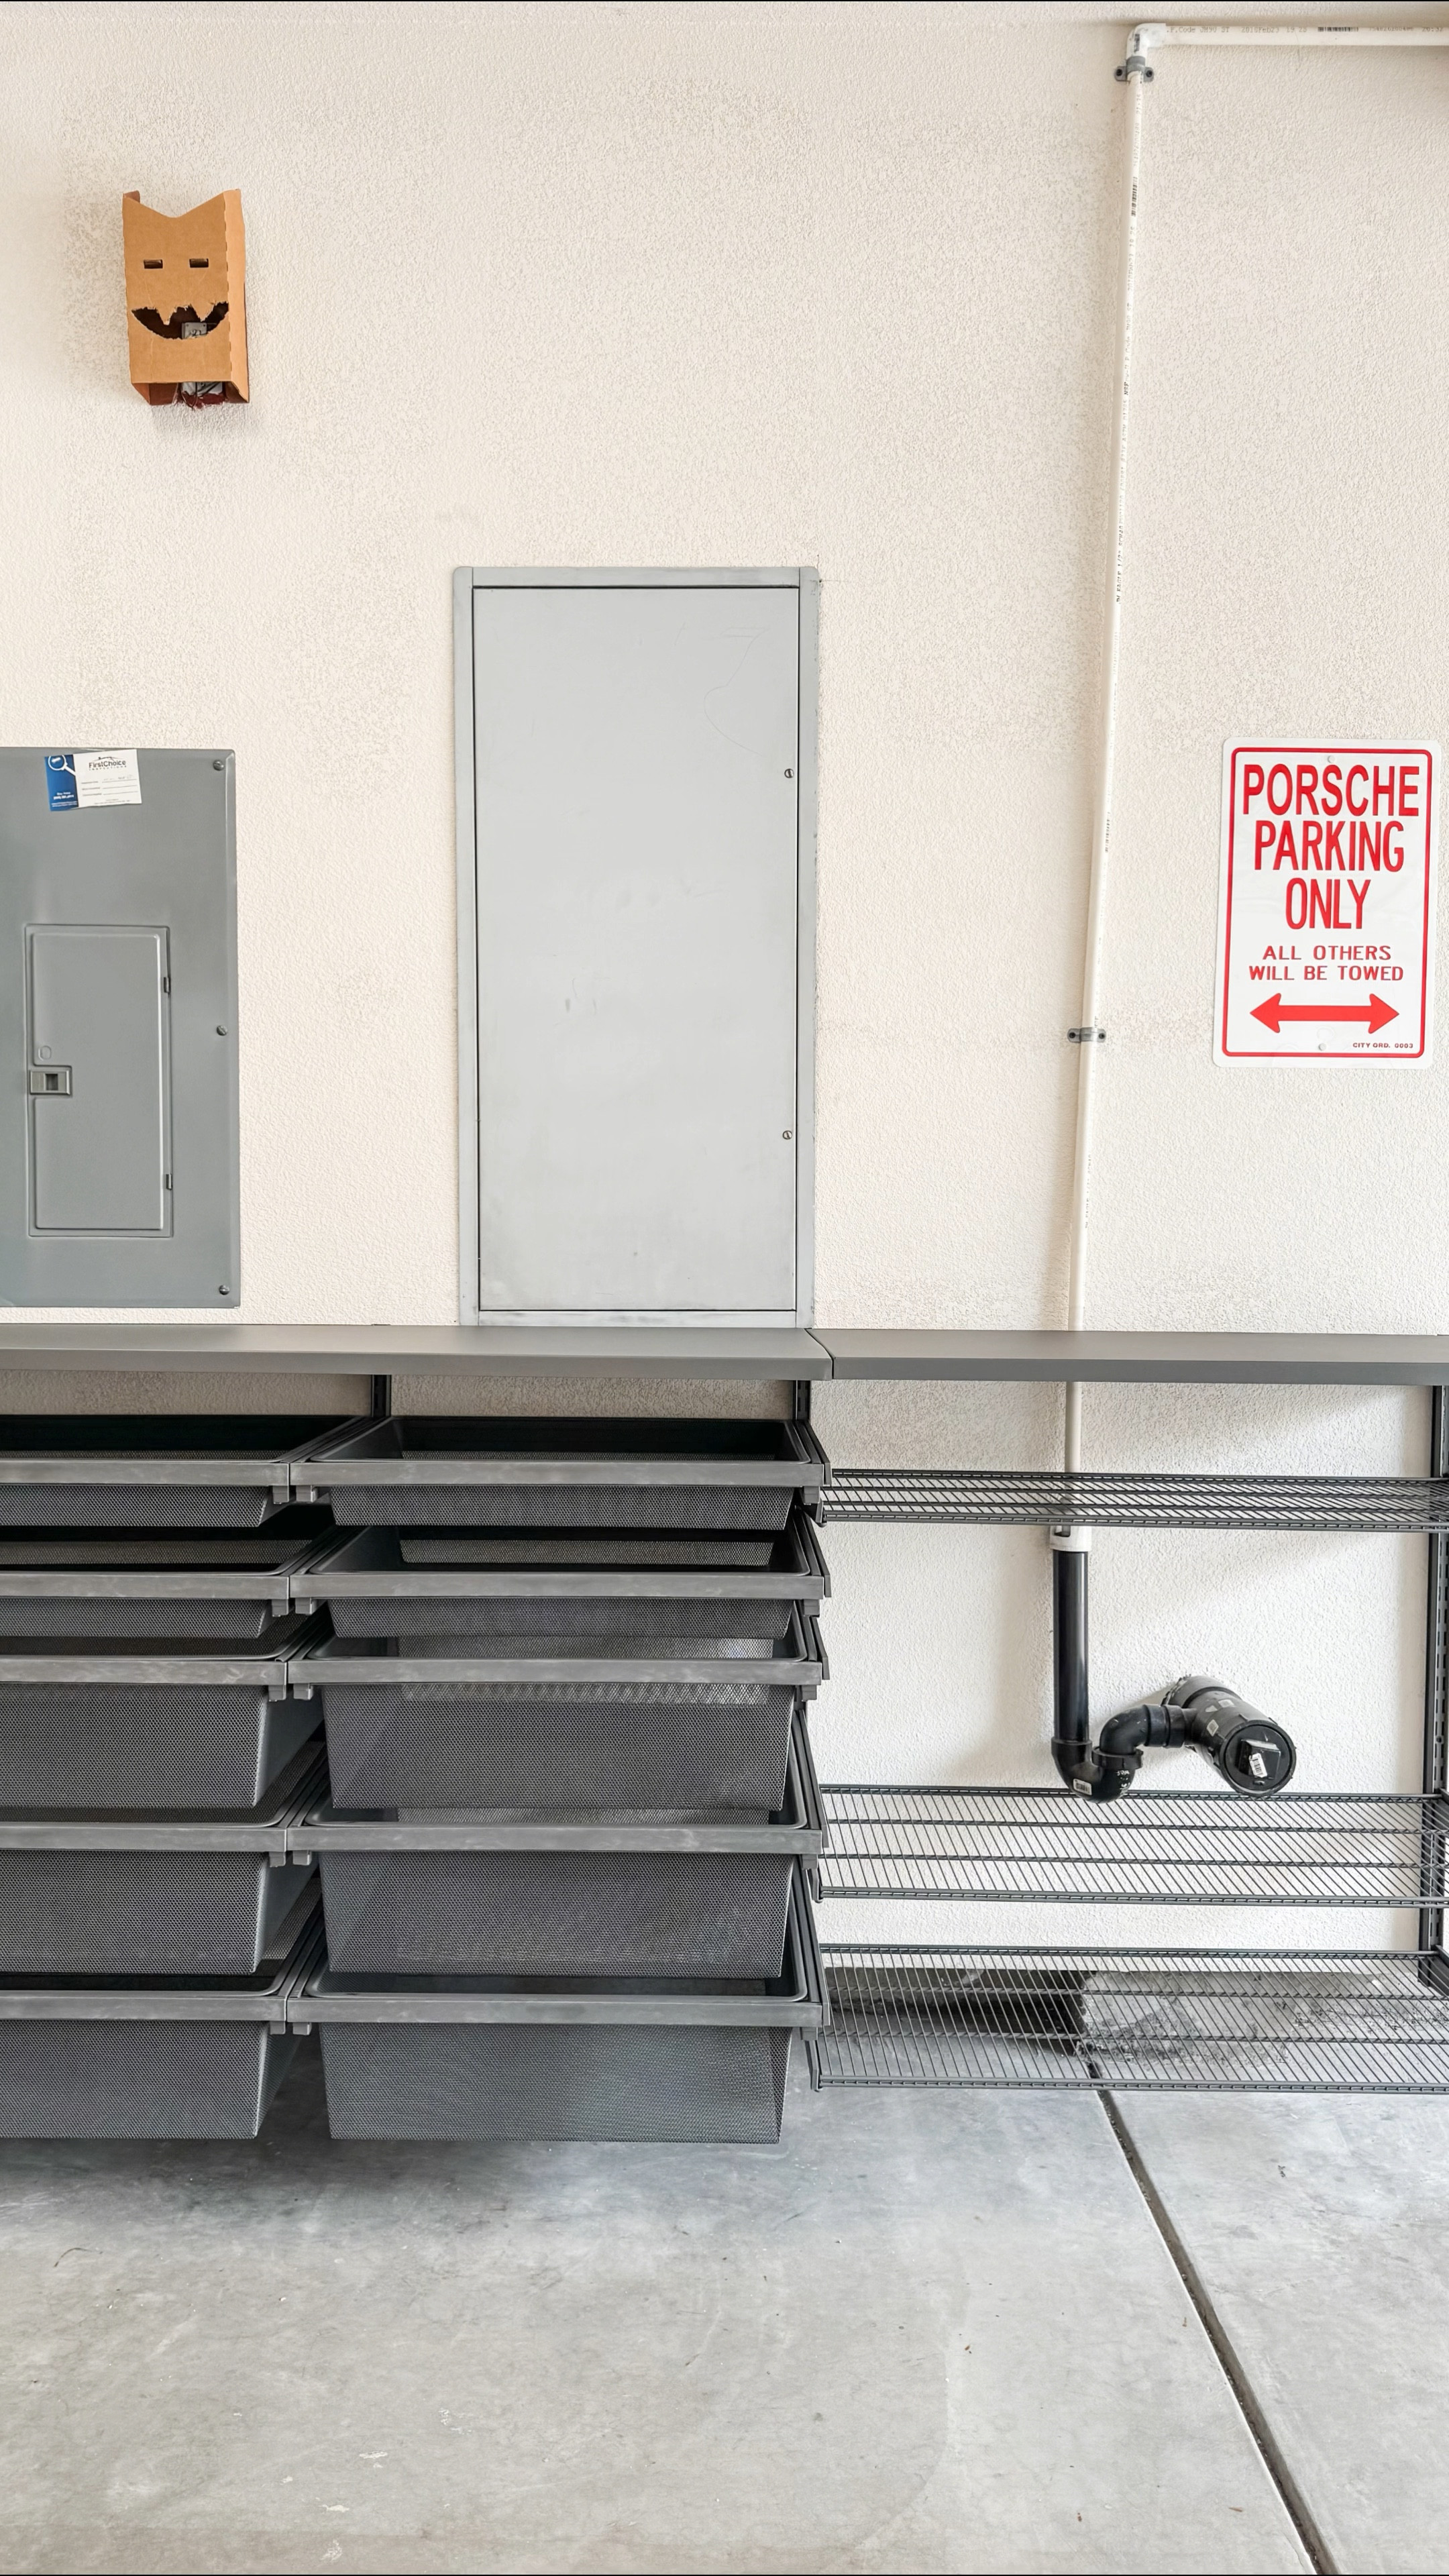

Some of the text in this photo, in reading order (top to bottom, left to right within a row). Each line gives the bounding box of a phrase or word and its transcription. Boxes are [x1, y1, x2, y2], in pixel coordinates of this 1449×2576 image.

[89, 760, 126, 768] FirstChoice
[1243, 763, 1419, 816] PORSCHE
[1254, 820, 1404, 872] PARKING
[1285, 877, 1371, 930] ONLY
[1263, 945, 1391, 961] ALL OTHERS
[1249, 965, 1403, 981] WILL BE TOWED
